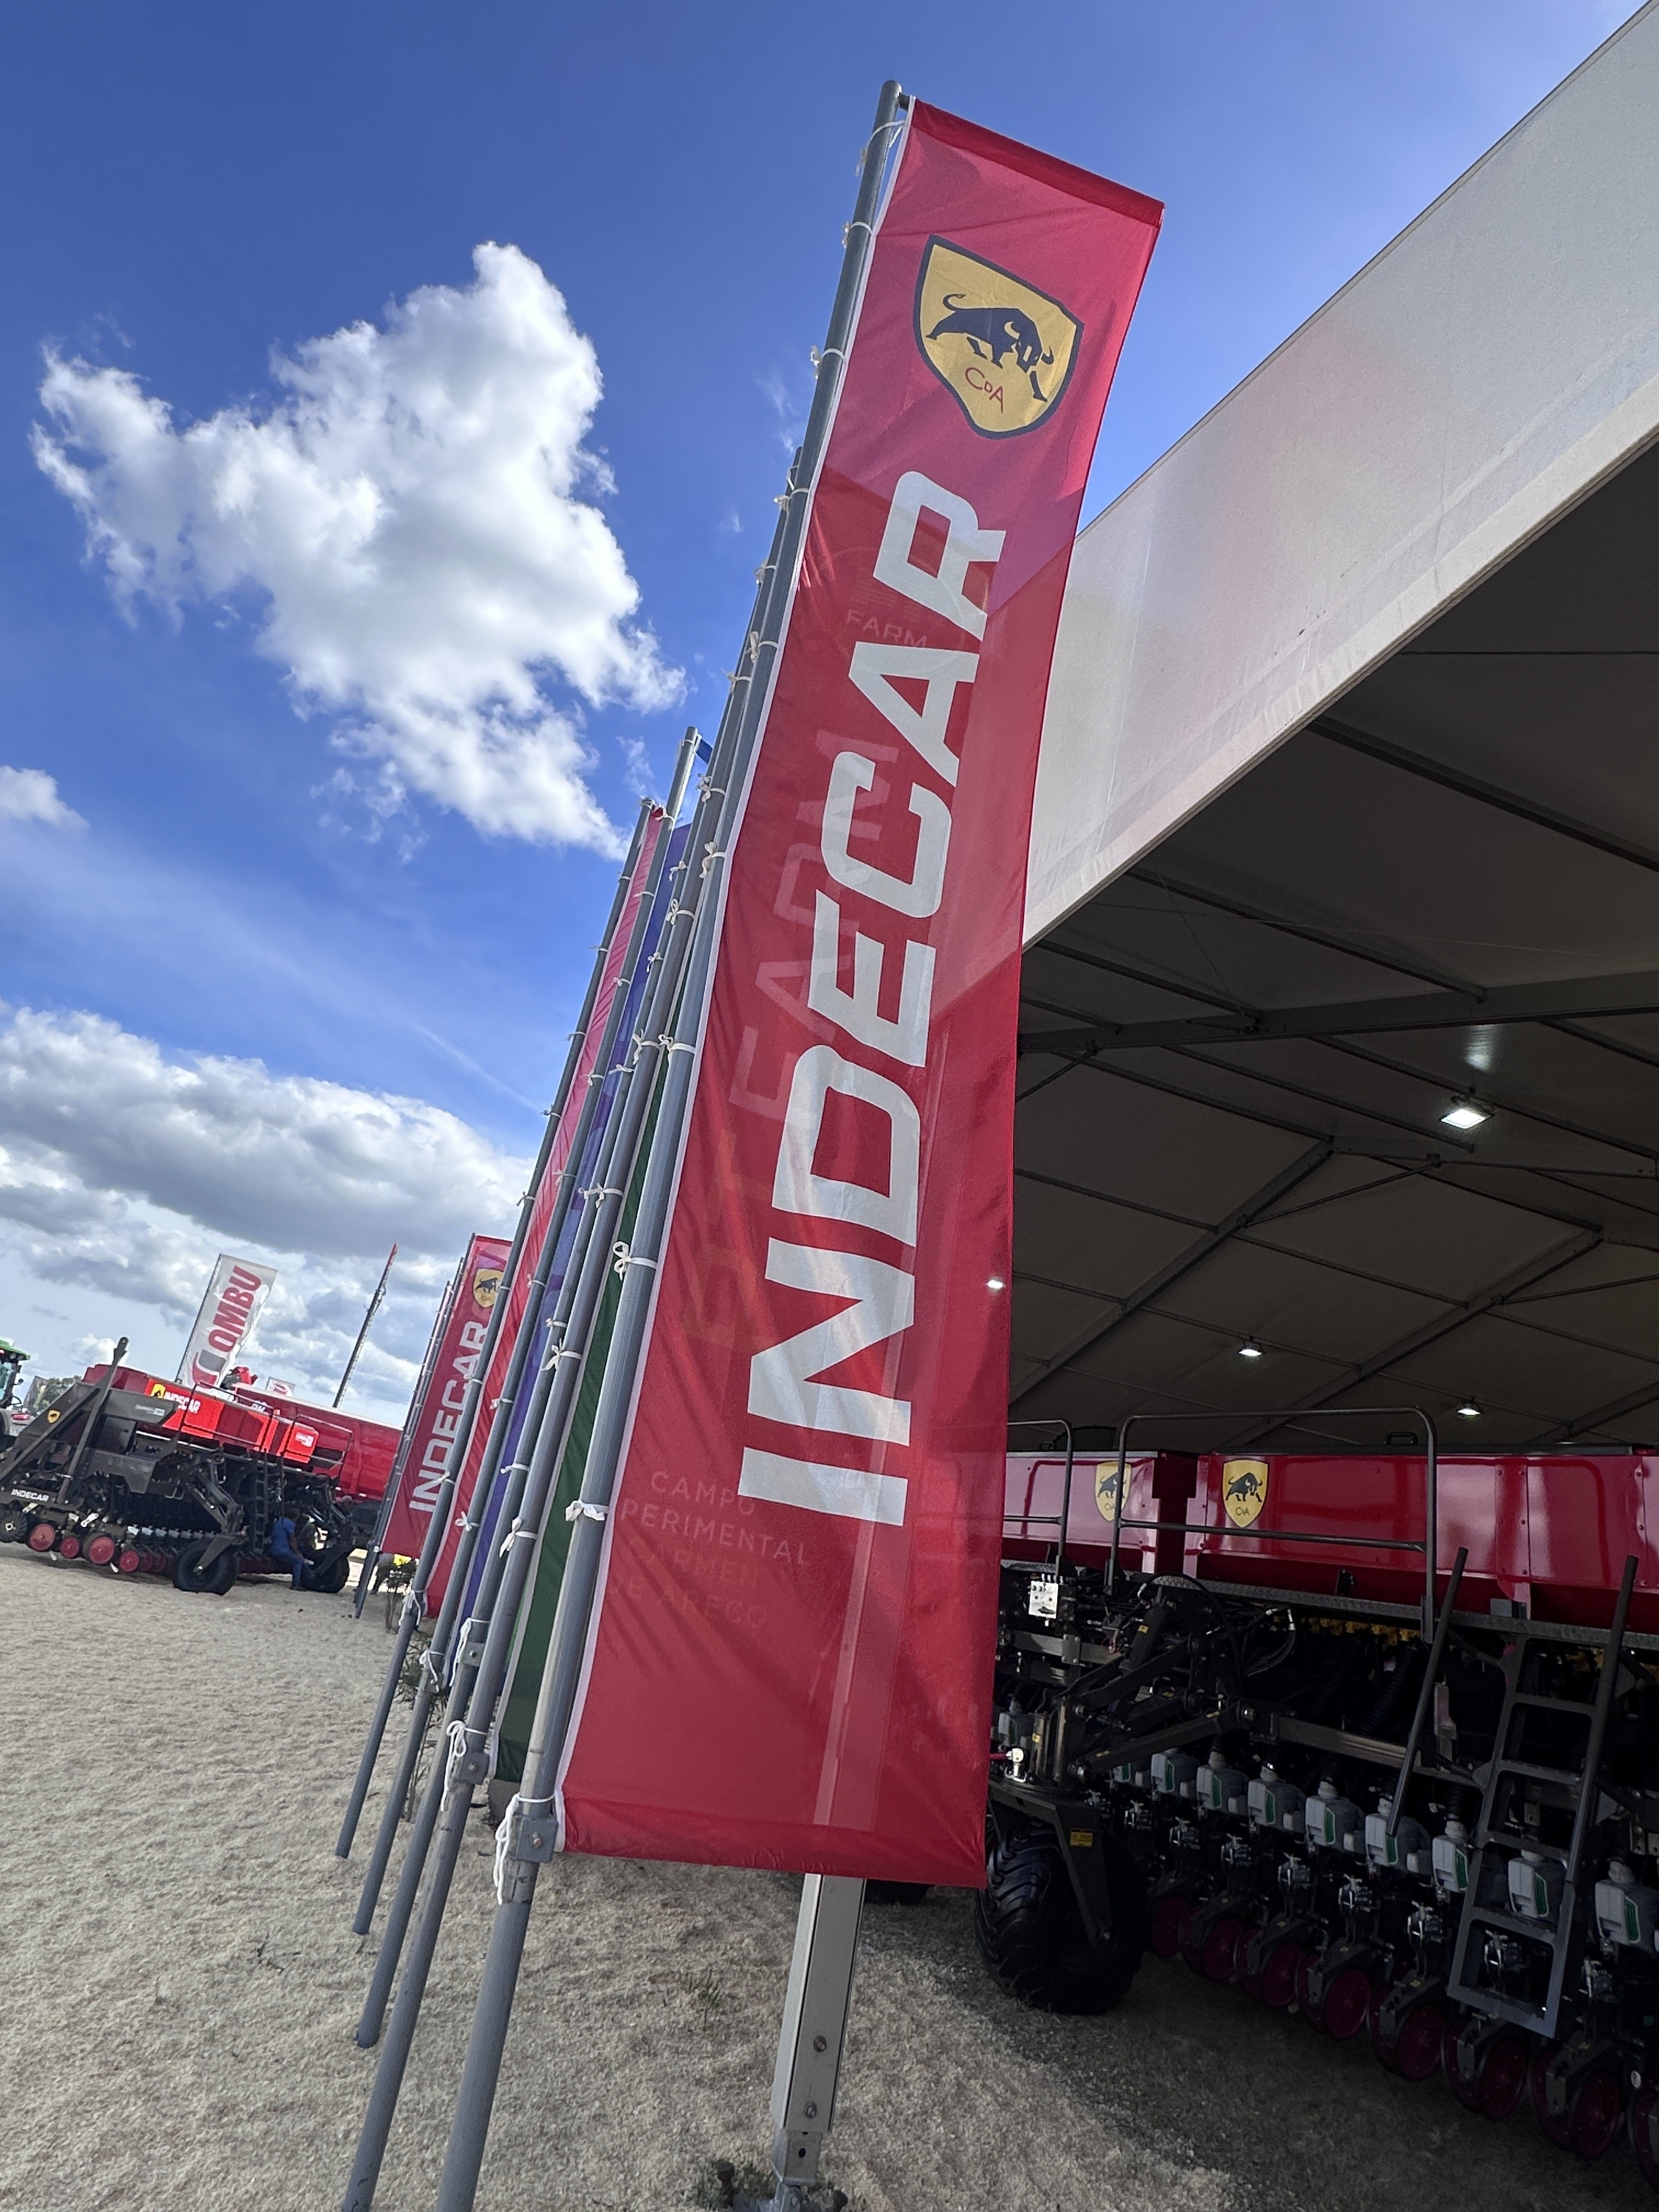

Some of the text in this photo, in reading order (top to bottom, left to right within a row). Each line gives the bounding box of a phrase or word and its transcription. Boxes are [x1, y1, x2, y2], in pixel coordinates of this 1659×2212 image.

[738, 471, 1007, 1527] INDECAR
[208, 1265, 262, 1353] OMBU
[409, 1321, 489, 1513] INDECAR
[11, 1488, 49, 1502] INDECAR
[620, 1498, 810, 1566] PERIMENTAL
[651, 1471, 755, 1516] CAMPO
